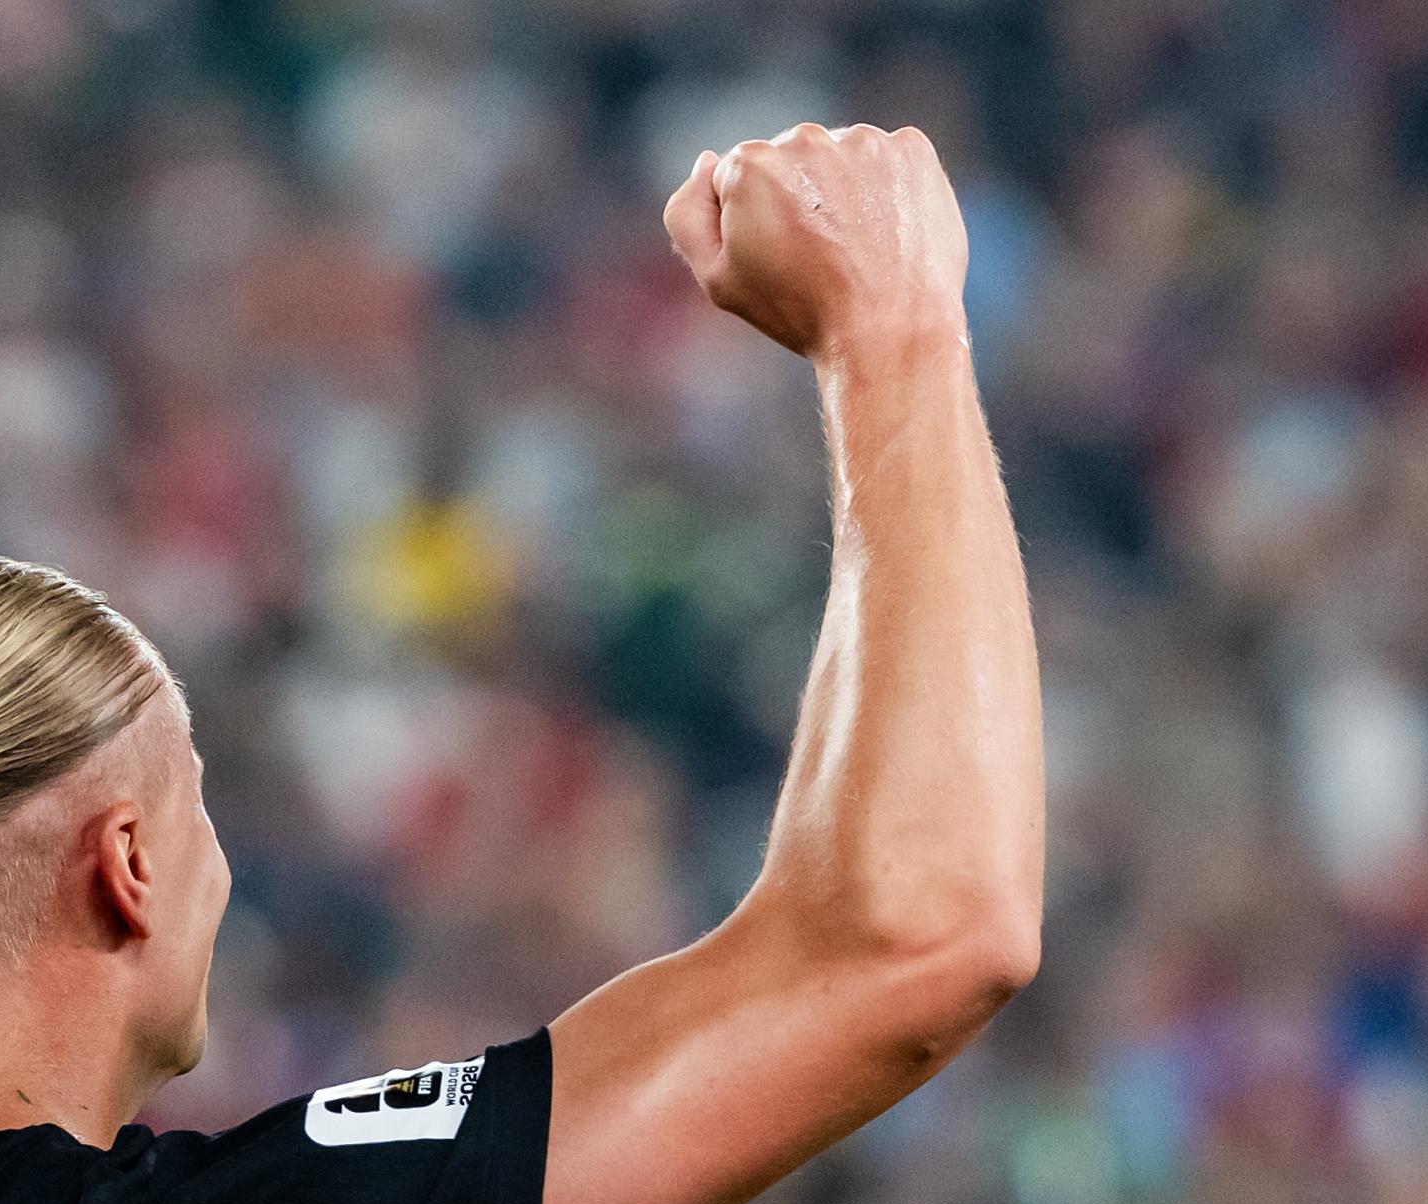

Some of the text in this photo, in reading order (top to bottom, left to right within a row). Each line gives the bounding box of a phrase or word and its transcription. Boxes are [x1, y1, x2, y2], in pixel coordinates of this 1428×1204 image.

[417, 1075, 432, 1095] FIFA
[446, 1078, 458, 1107] WORLD
[459, 1065, 479, 1106] 2026
